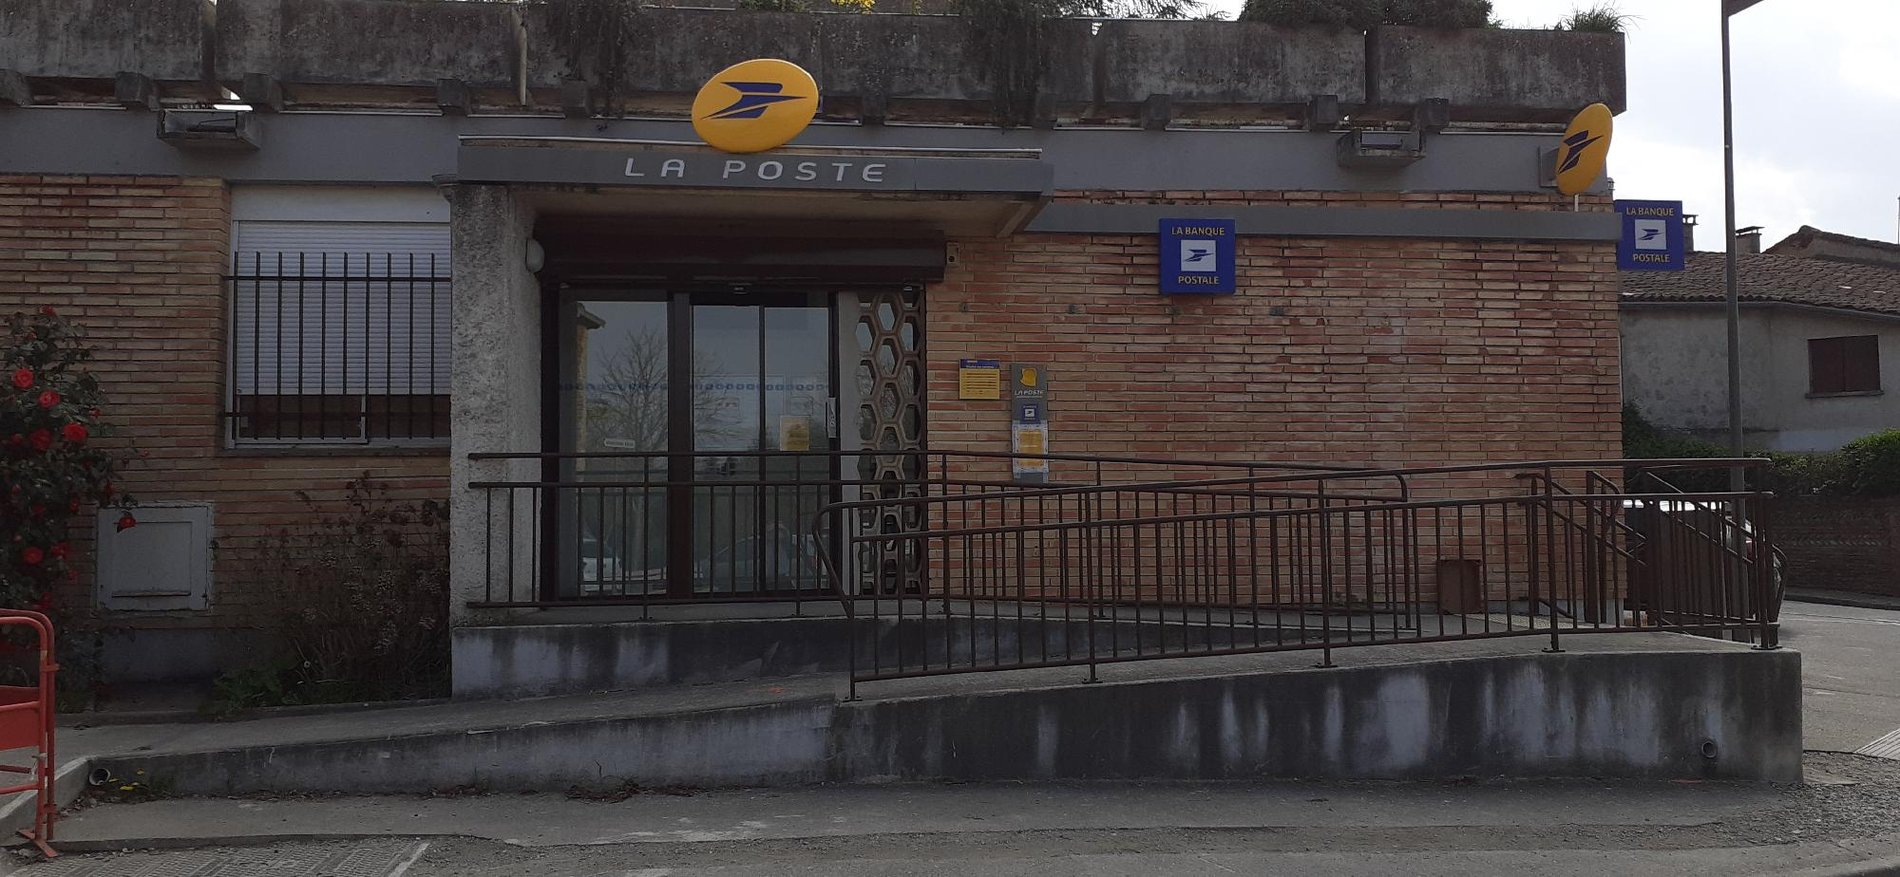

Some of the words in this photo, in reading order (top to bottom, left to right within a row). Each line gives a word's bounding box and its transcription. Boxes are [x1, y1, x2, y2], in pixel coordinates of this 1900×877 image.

[625, 157, 685, 178] LA
[722, 160, 887, 182] POSTE
[1626, 207, 1637, 216] LA
[1638, 207, 1675, 216] BANQUE
[1171, 226, 1183, 235] LA
[1185, 226, 1225, 236] BANQUE
[1633, 253, 1671, 263] POSTALE
[1178, 275, 1220, 285] POSTALE
